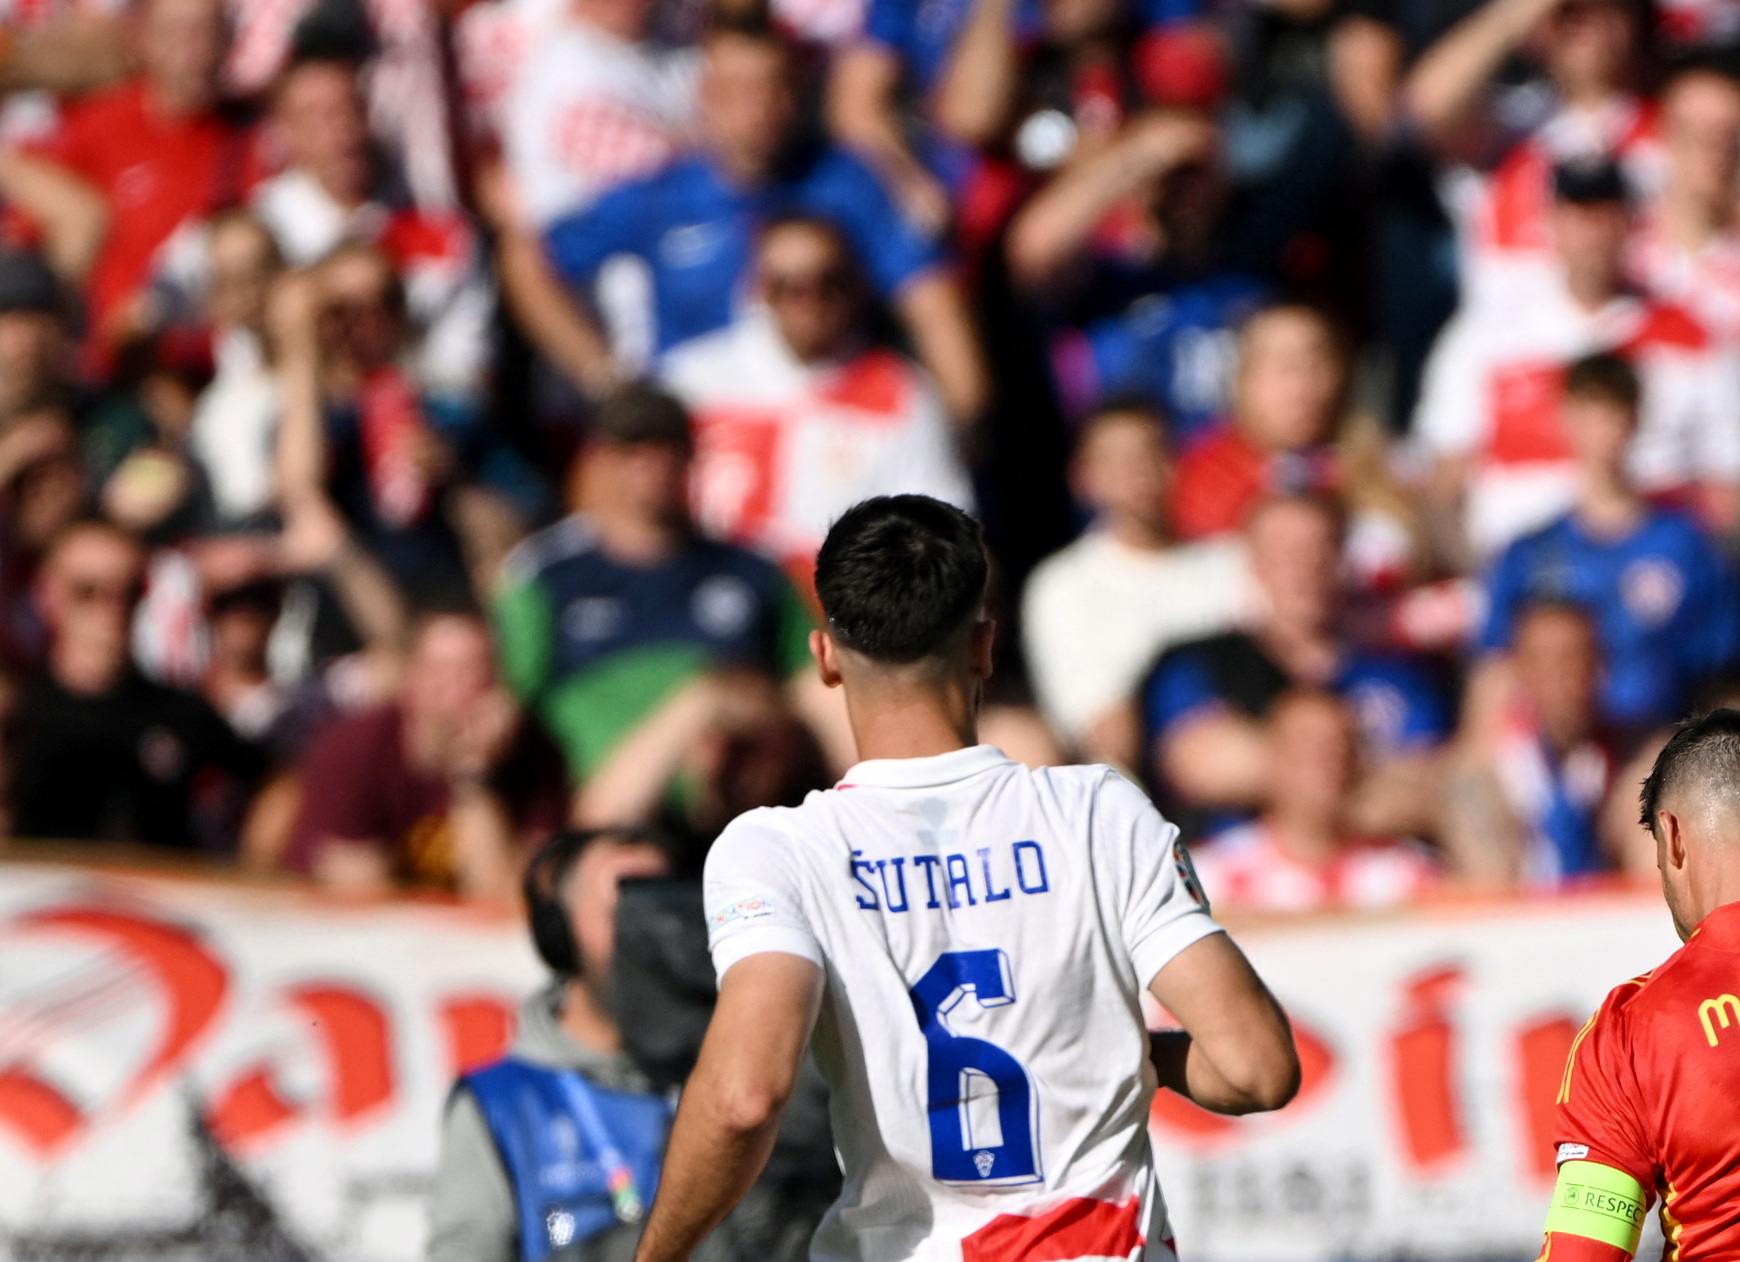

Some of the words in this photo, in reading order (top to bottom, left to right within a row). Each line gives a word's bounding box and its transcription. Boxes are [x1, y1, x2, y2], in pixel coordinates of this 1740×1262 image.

[850, 839, 1050, 913] ŠUTALO
[908, 948, 1045, 1188] 6
[1584, 1191, 1645, 1223] RESPEC
